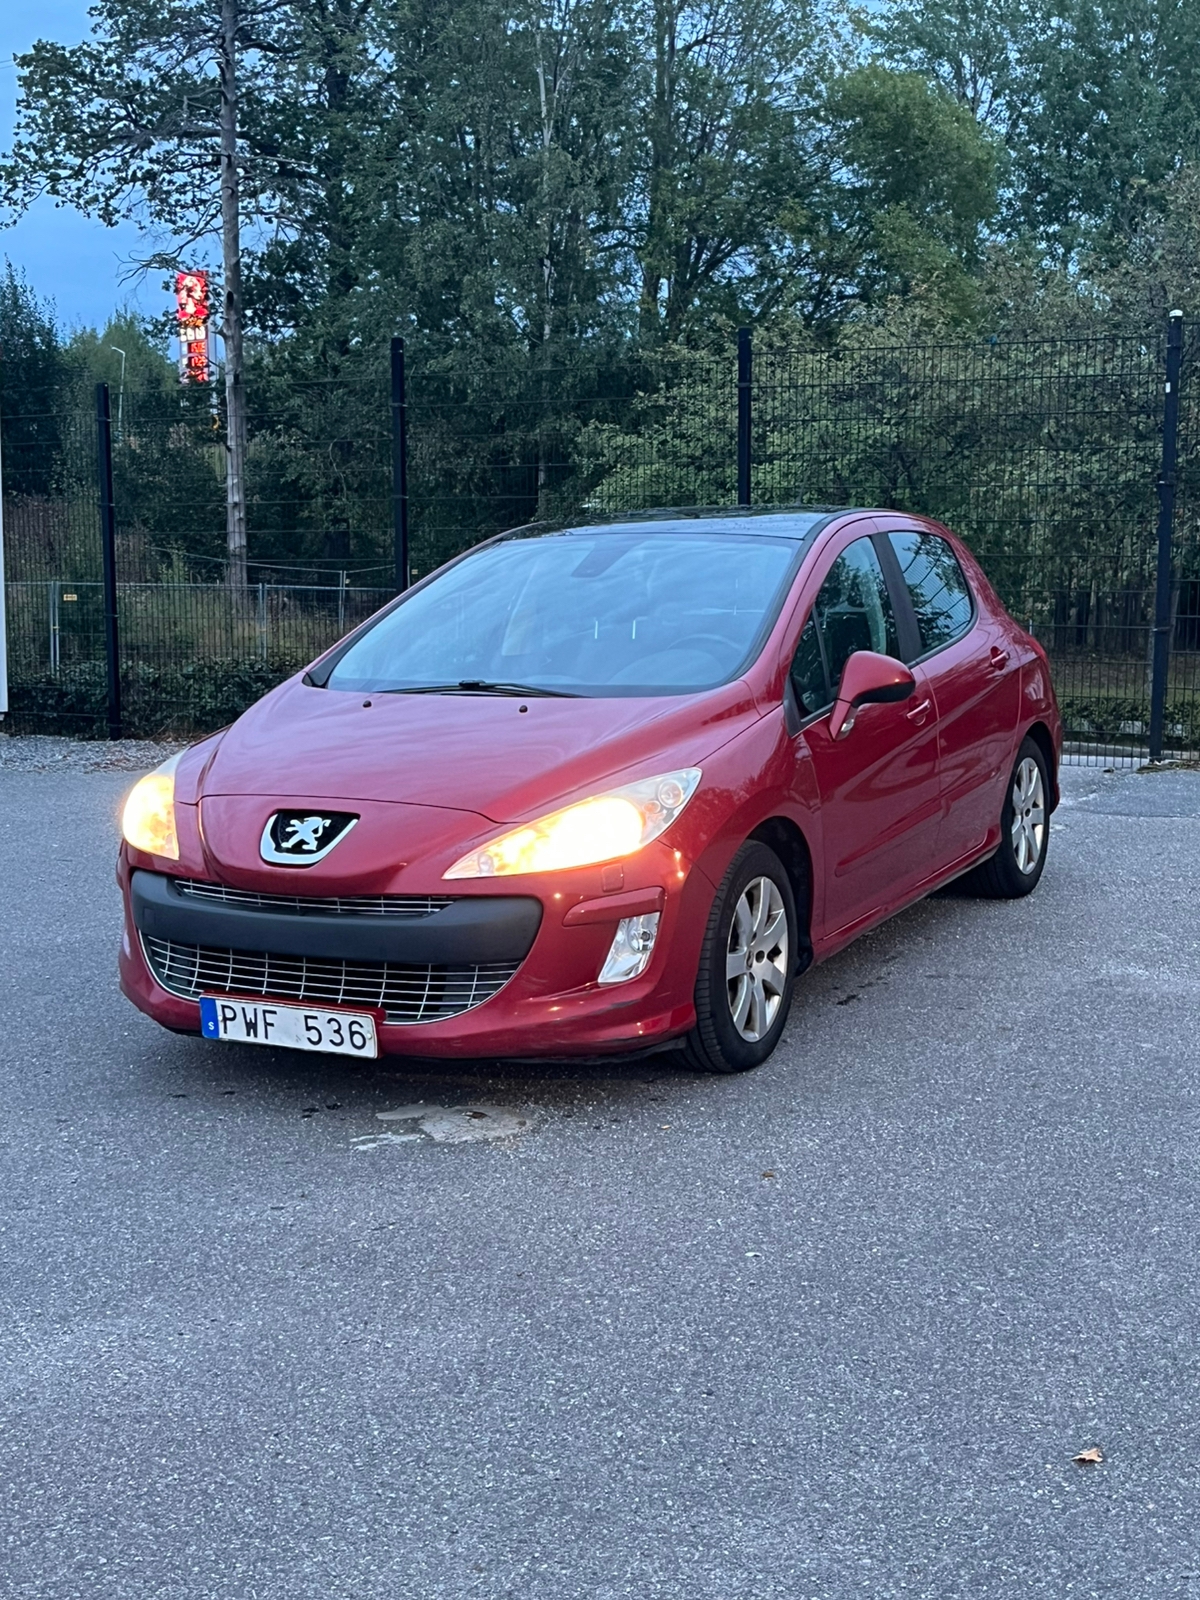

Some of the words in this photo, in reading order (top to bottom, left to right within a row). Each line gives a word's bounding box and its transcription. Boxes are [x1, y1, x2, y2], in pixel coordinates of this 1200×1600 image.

[208, 1021, 215, 1031] S
[220, 1004, 278, 1040] PWF
[304, 1015, 367, 1050] 536
